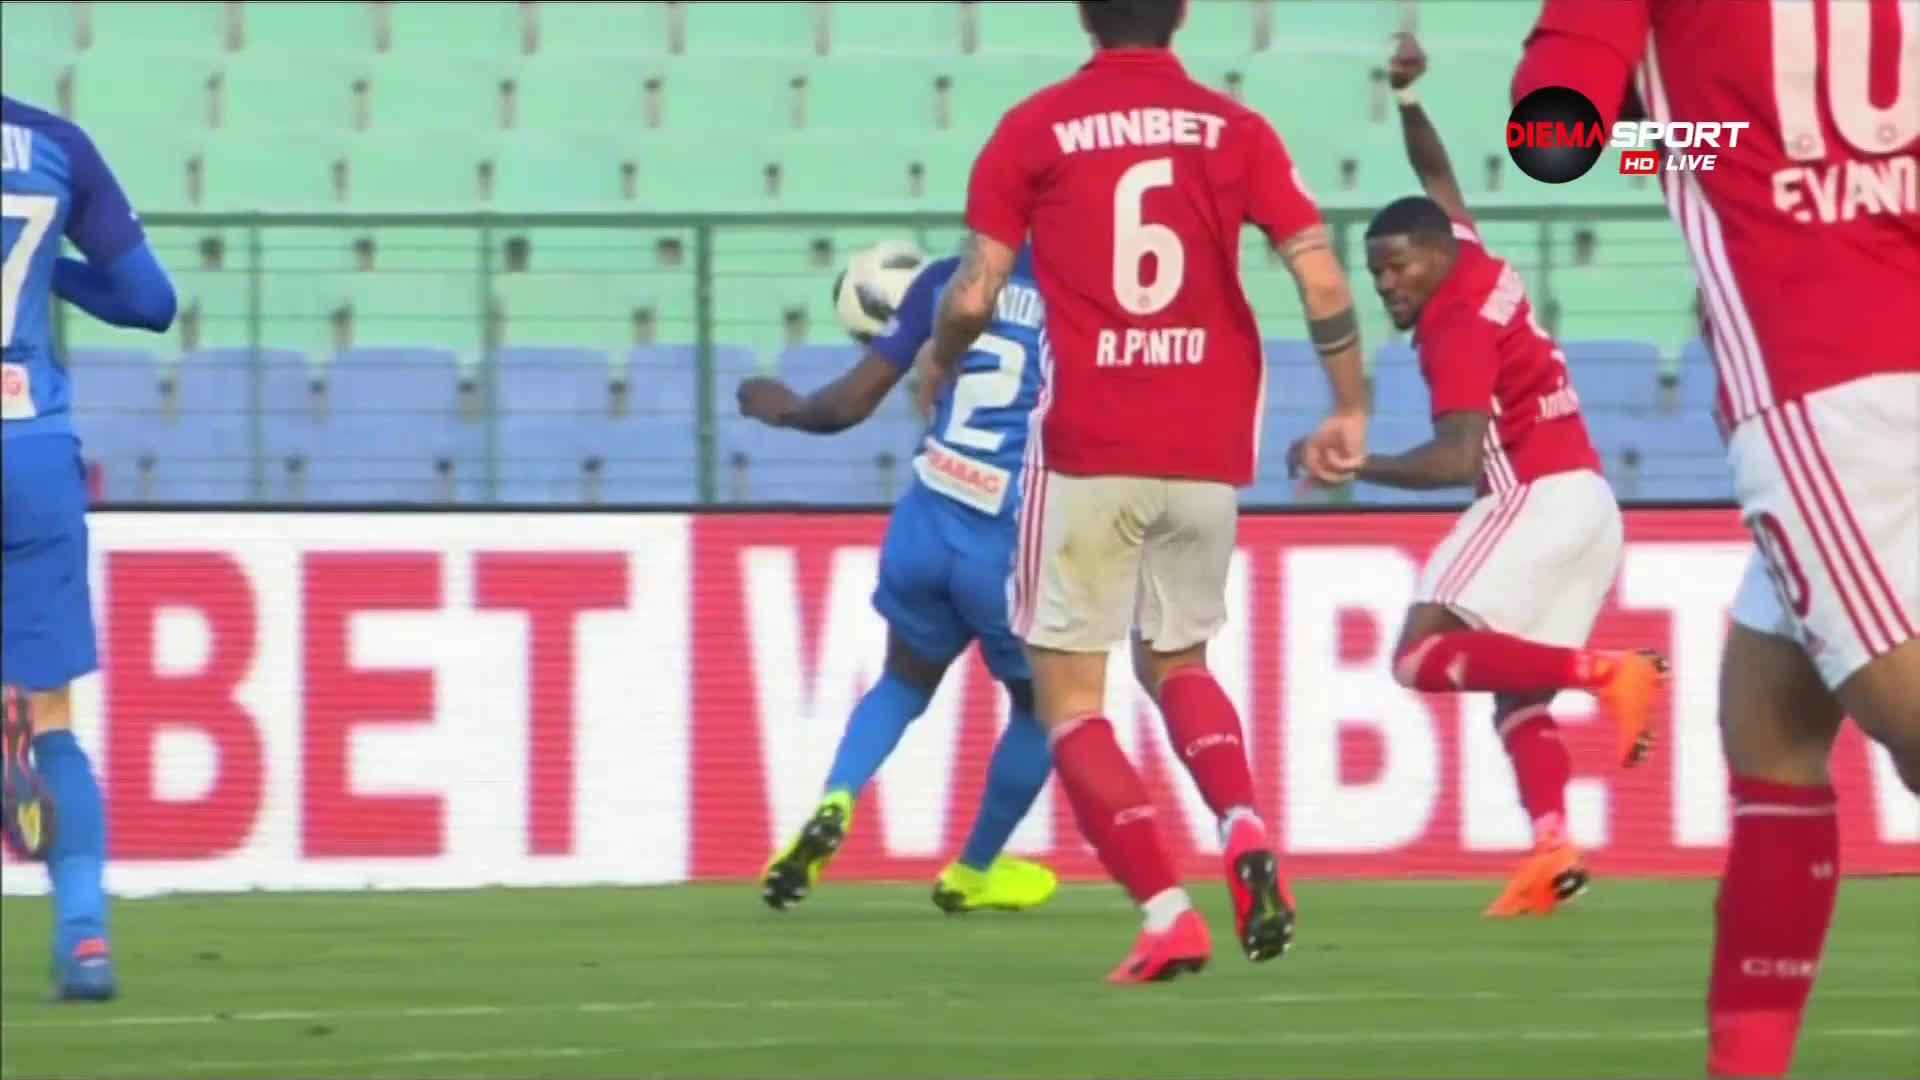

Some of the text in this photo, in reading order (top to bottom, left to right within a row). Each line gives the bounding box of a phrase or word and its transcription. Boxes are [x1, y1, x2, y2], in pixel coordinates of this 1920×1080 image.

[1053, 108, 1227, 153] WINBET
[1771, 0, 1920, 161] 10
[1112, 157, 1185, 316] 6
[1771, 156, 1918, 224] EVAN
[943, 331, 1027, 453] 2
[103, 550, 629, 861] BET
